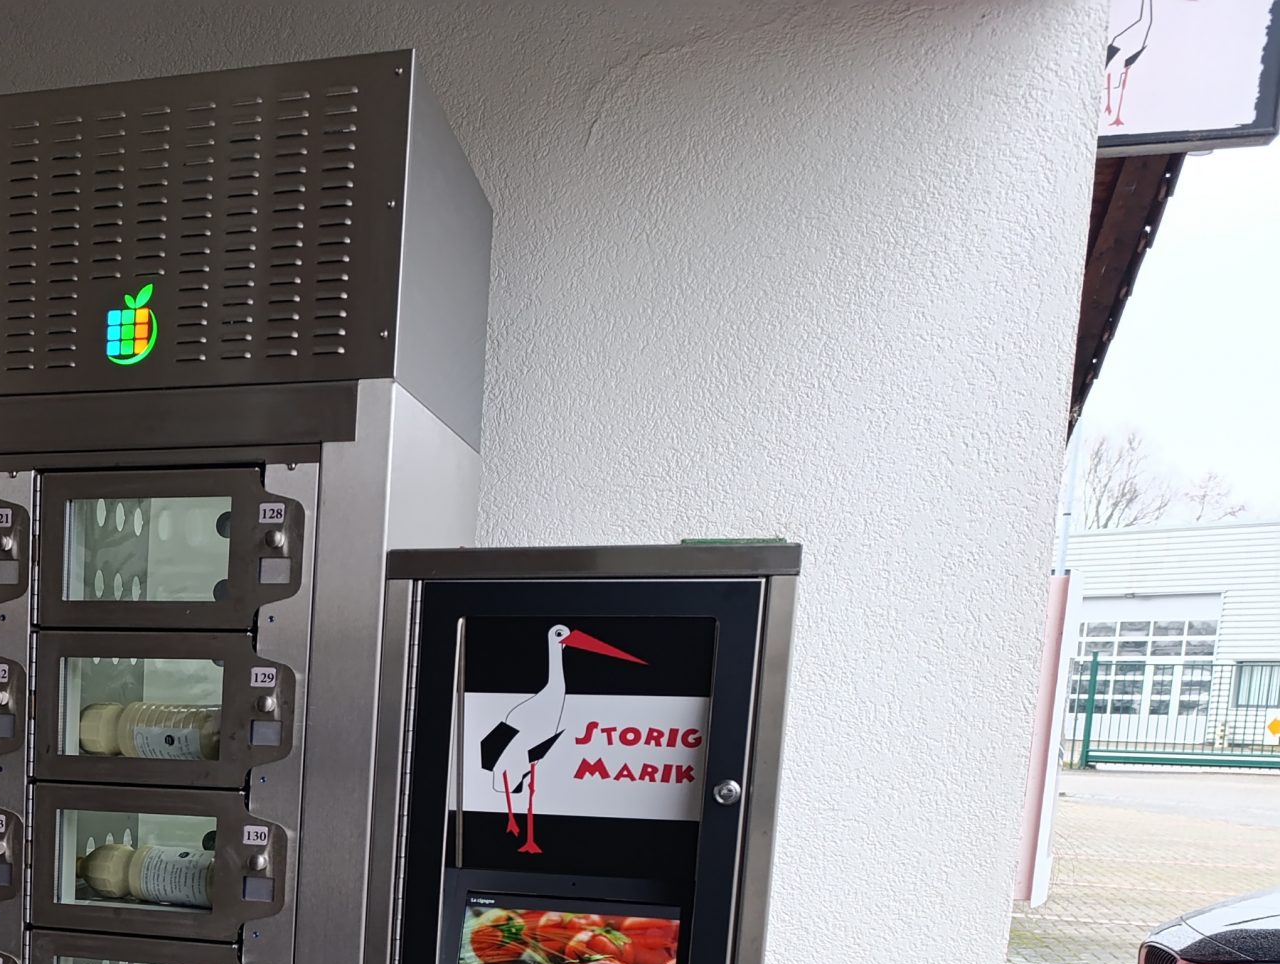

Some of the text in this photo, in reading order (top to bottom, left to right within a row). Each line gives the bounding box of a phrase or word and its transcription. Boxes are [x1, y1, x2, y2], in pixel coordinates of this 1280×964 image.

[261, 508, 284, 520] 128
[252, 671, 274, 684] 129
[575, 721, 702, 749] STORIG
[574, 757, 695, 784] MARIK
[245, 830, 267, 842] 130
